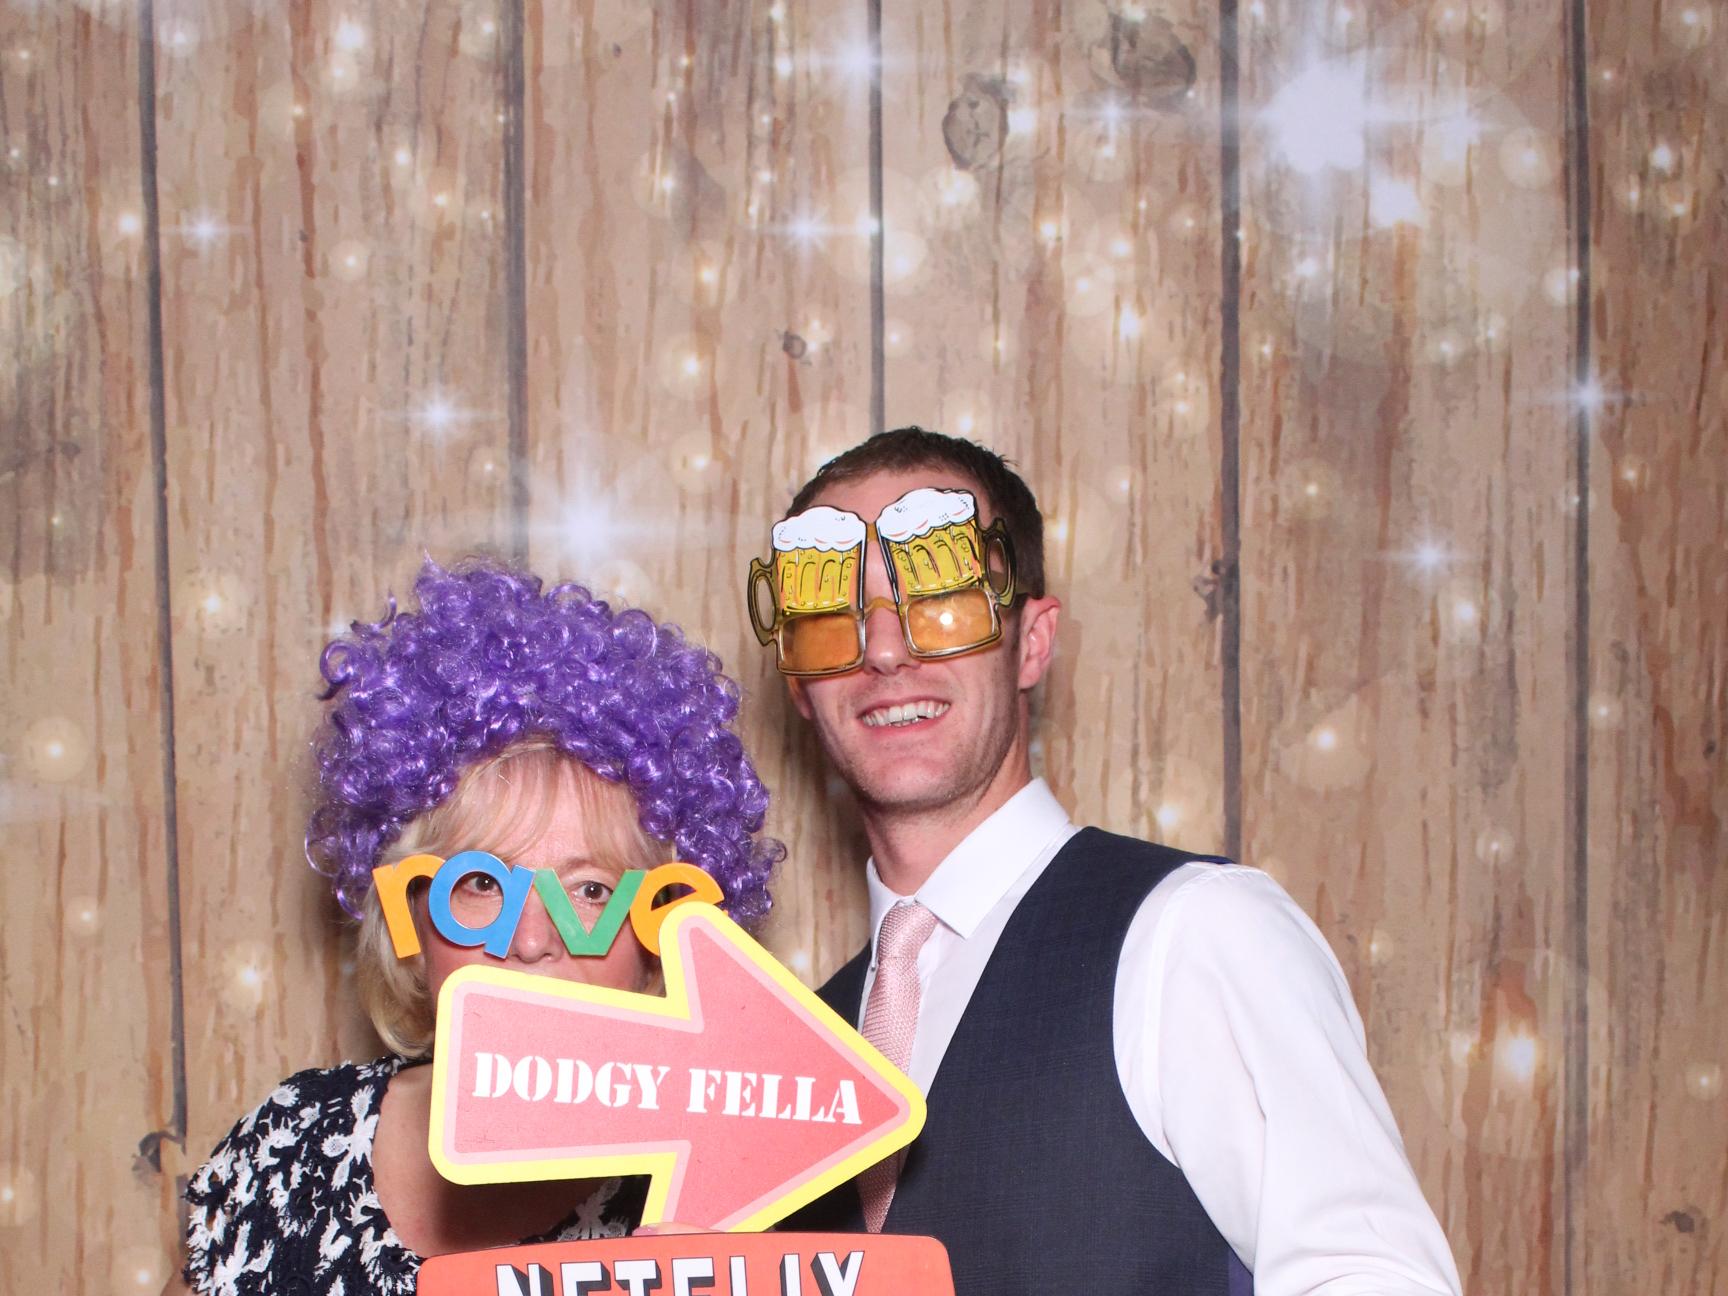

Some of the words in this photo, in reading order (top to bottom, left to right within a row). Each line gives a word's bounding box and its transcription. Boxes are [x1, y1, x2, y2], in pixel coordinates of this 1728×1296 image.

[372, 850, 727, 960] rave
[472, 1051, 670, 1110] DODGY
[686, 1067, 862, 1125] FELLA
